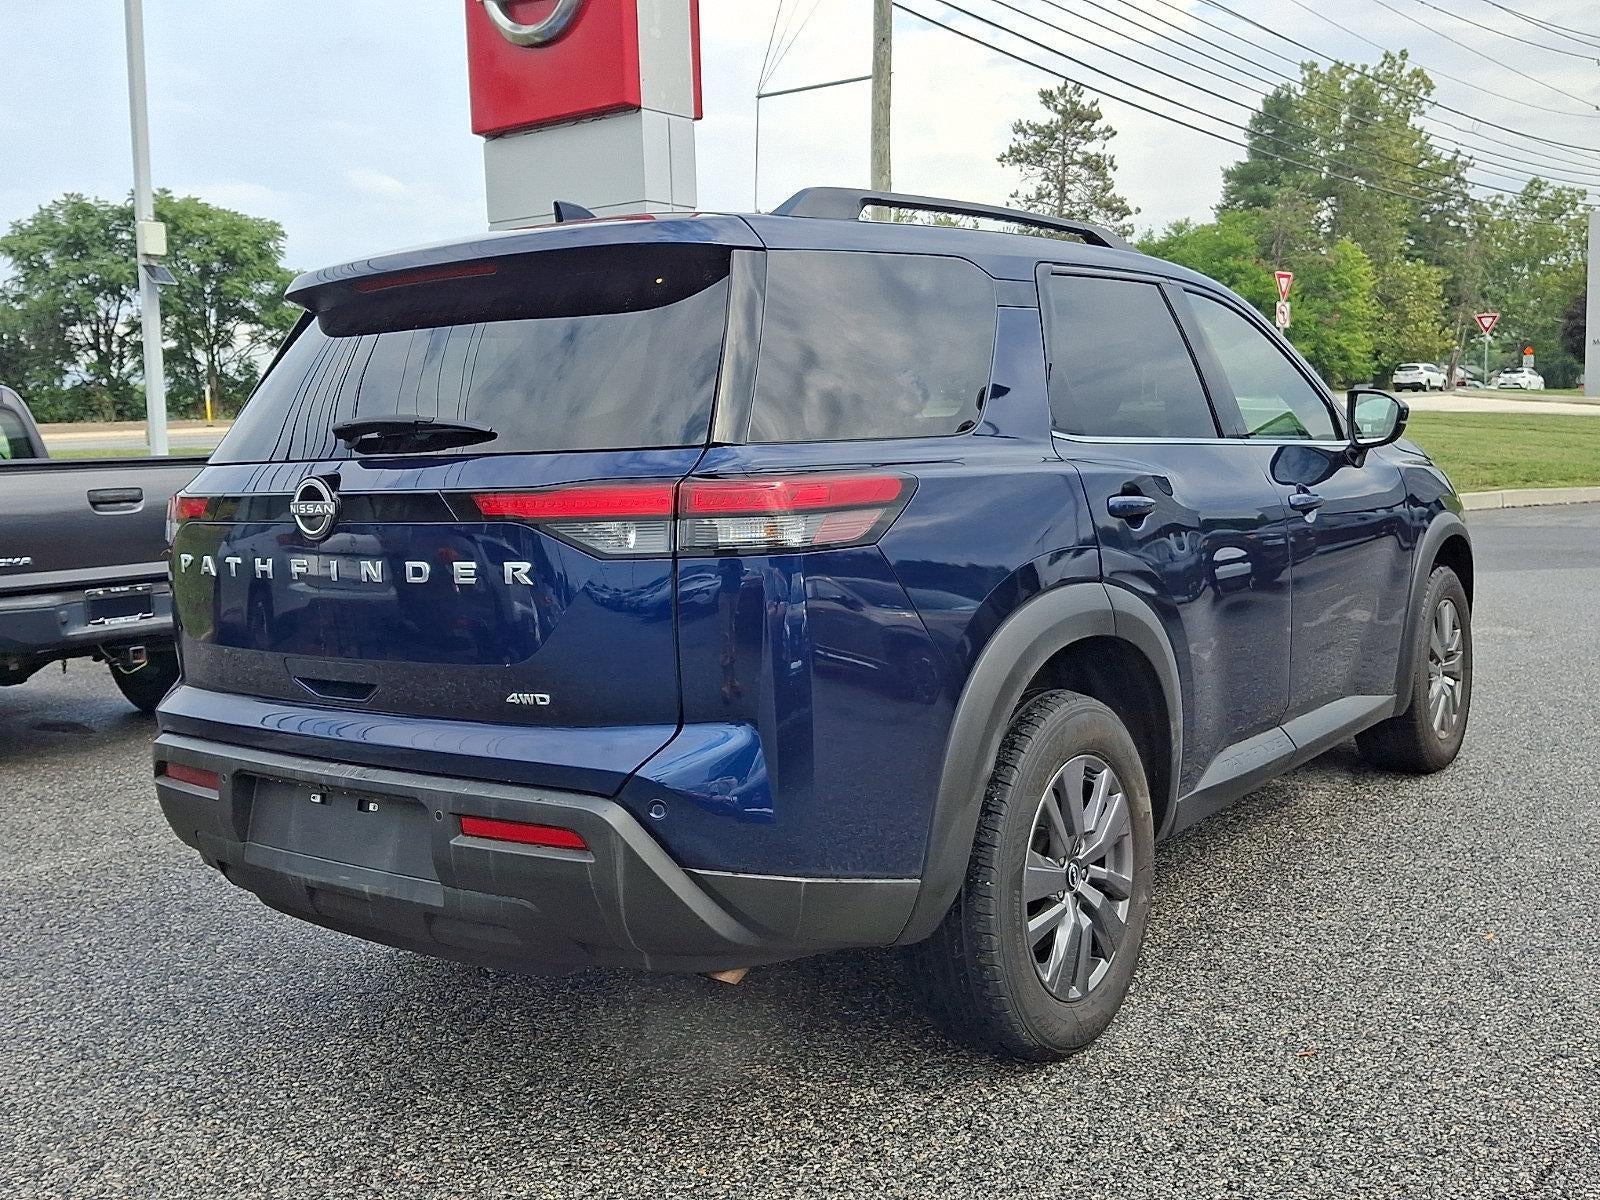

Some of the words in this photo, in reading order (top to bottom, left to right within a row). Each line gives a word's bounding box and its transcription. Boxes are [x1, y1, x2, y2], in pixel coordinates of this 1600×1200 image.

[290, 504, 333, 514] NISSAN
[179, 553, 534, 586] PATHFINDER
[506, 693, 550, 705] 4WD
